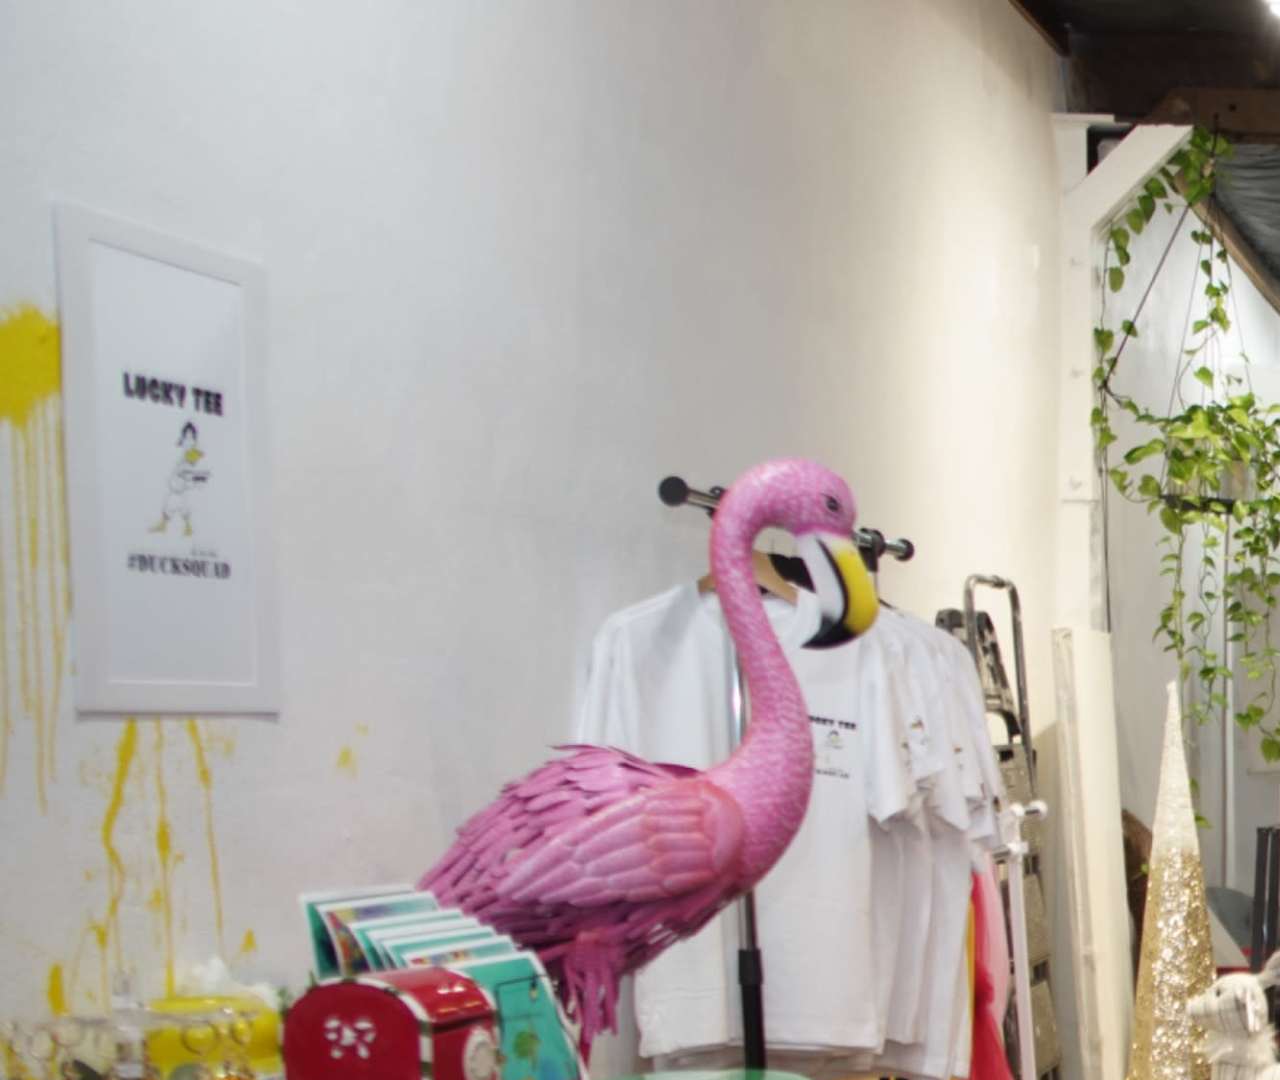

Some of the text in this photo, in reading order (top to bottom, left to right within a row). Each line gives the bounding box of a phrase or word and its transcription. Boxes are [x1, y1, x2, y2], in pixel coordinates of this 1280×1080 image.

[123, 371, 223, 416] LUCKY TEE
[126, 553, 231, 579] #DUCKSQUAD
